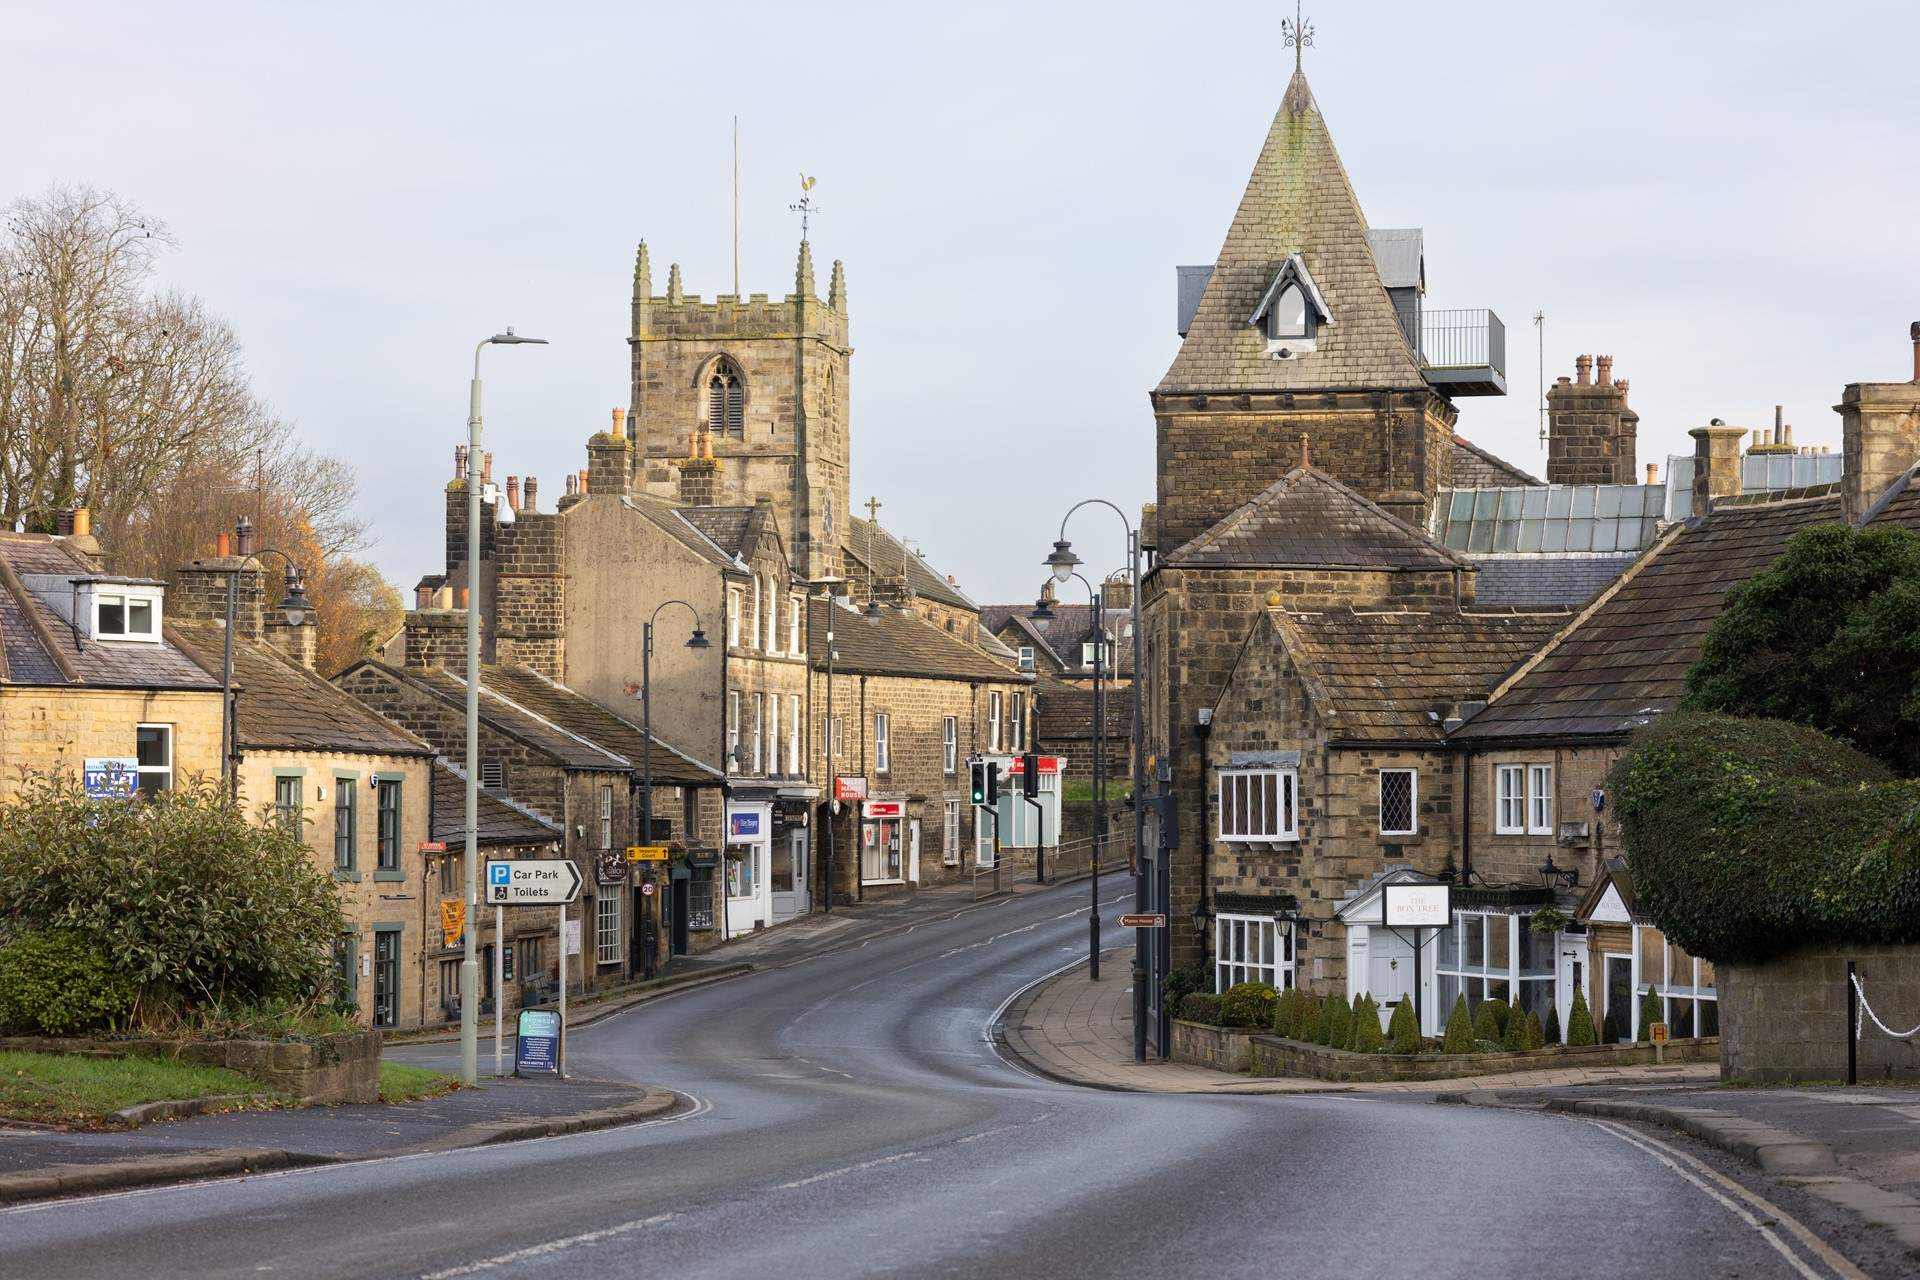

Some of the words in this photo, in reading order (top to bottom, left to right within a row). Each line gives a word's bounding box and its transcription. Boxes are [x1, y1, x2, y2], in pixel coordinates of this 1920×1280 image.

[88, 772, 108, 786] TO
[111, 772, 136, 786] LET
[495, 867, 507, 883] P
[513, 870, 533, 879] Car
[535, 870, 559, 879] Park
[513, 887, 549, 896] Toilets
[1409, 896, 1424, 904] THE
[1395, 904, 1415, 912] BOX
[1417, 904, 1440, 912] TREE
[1653, 1027, 1664, 1040] H
